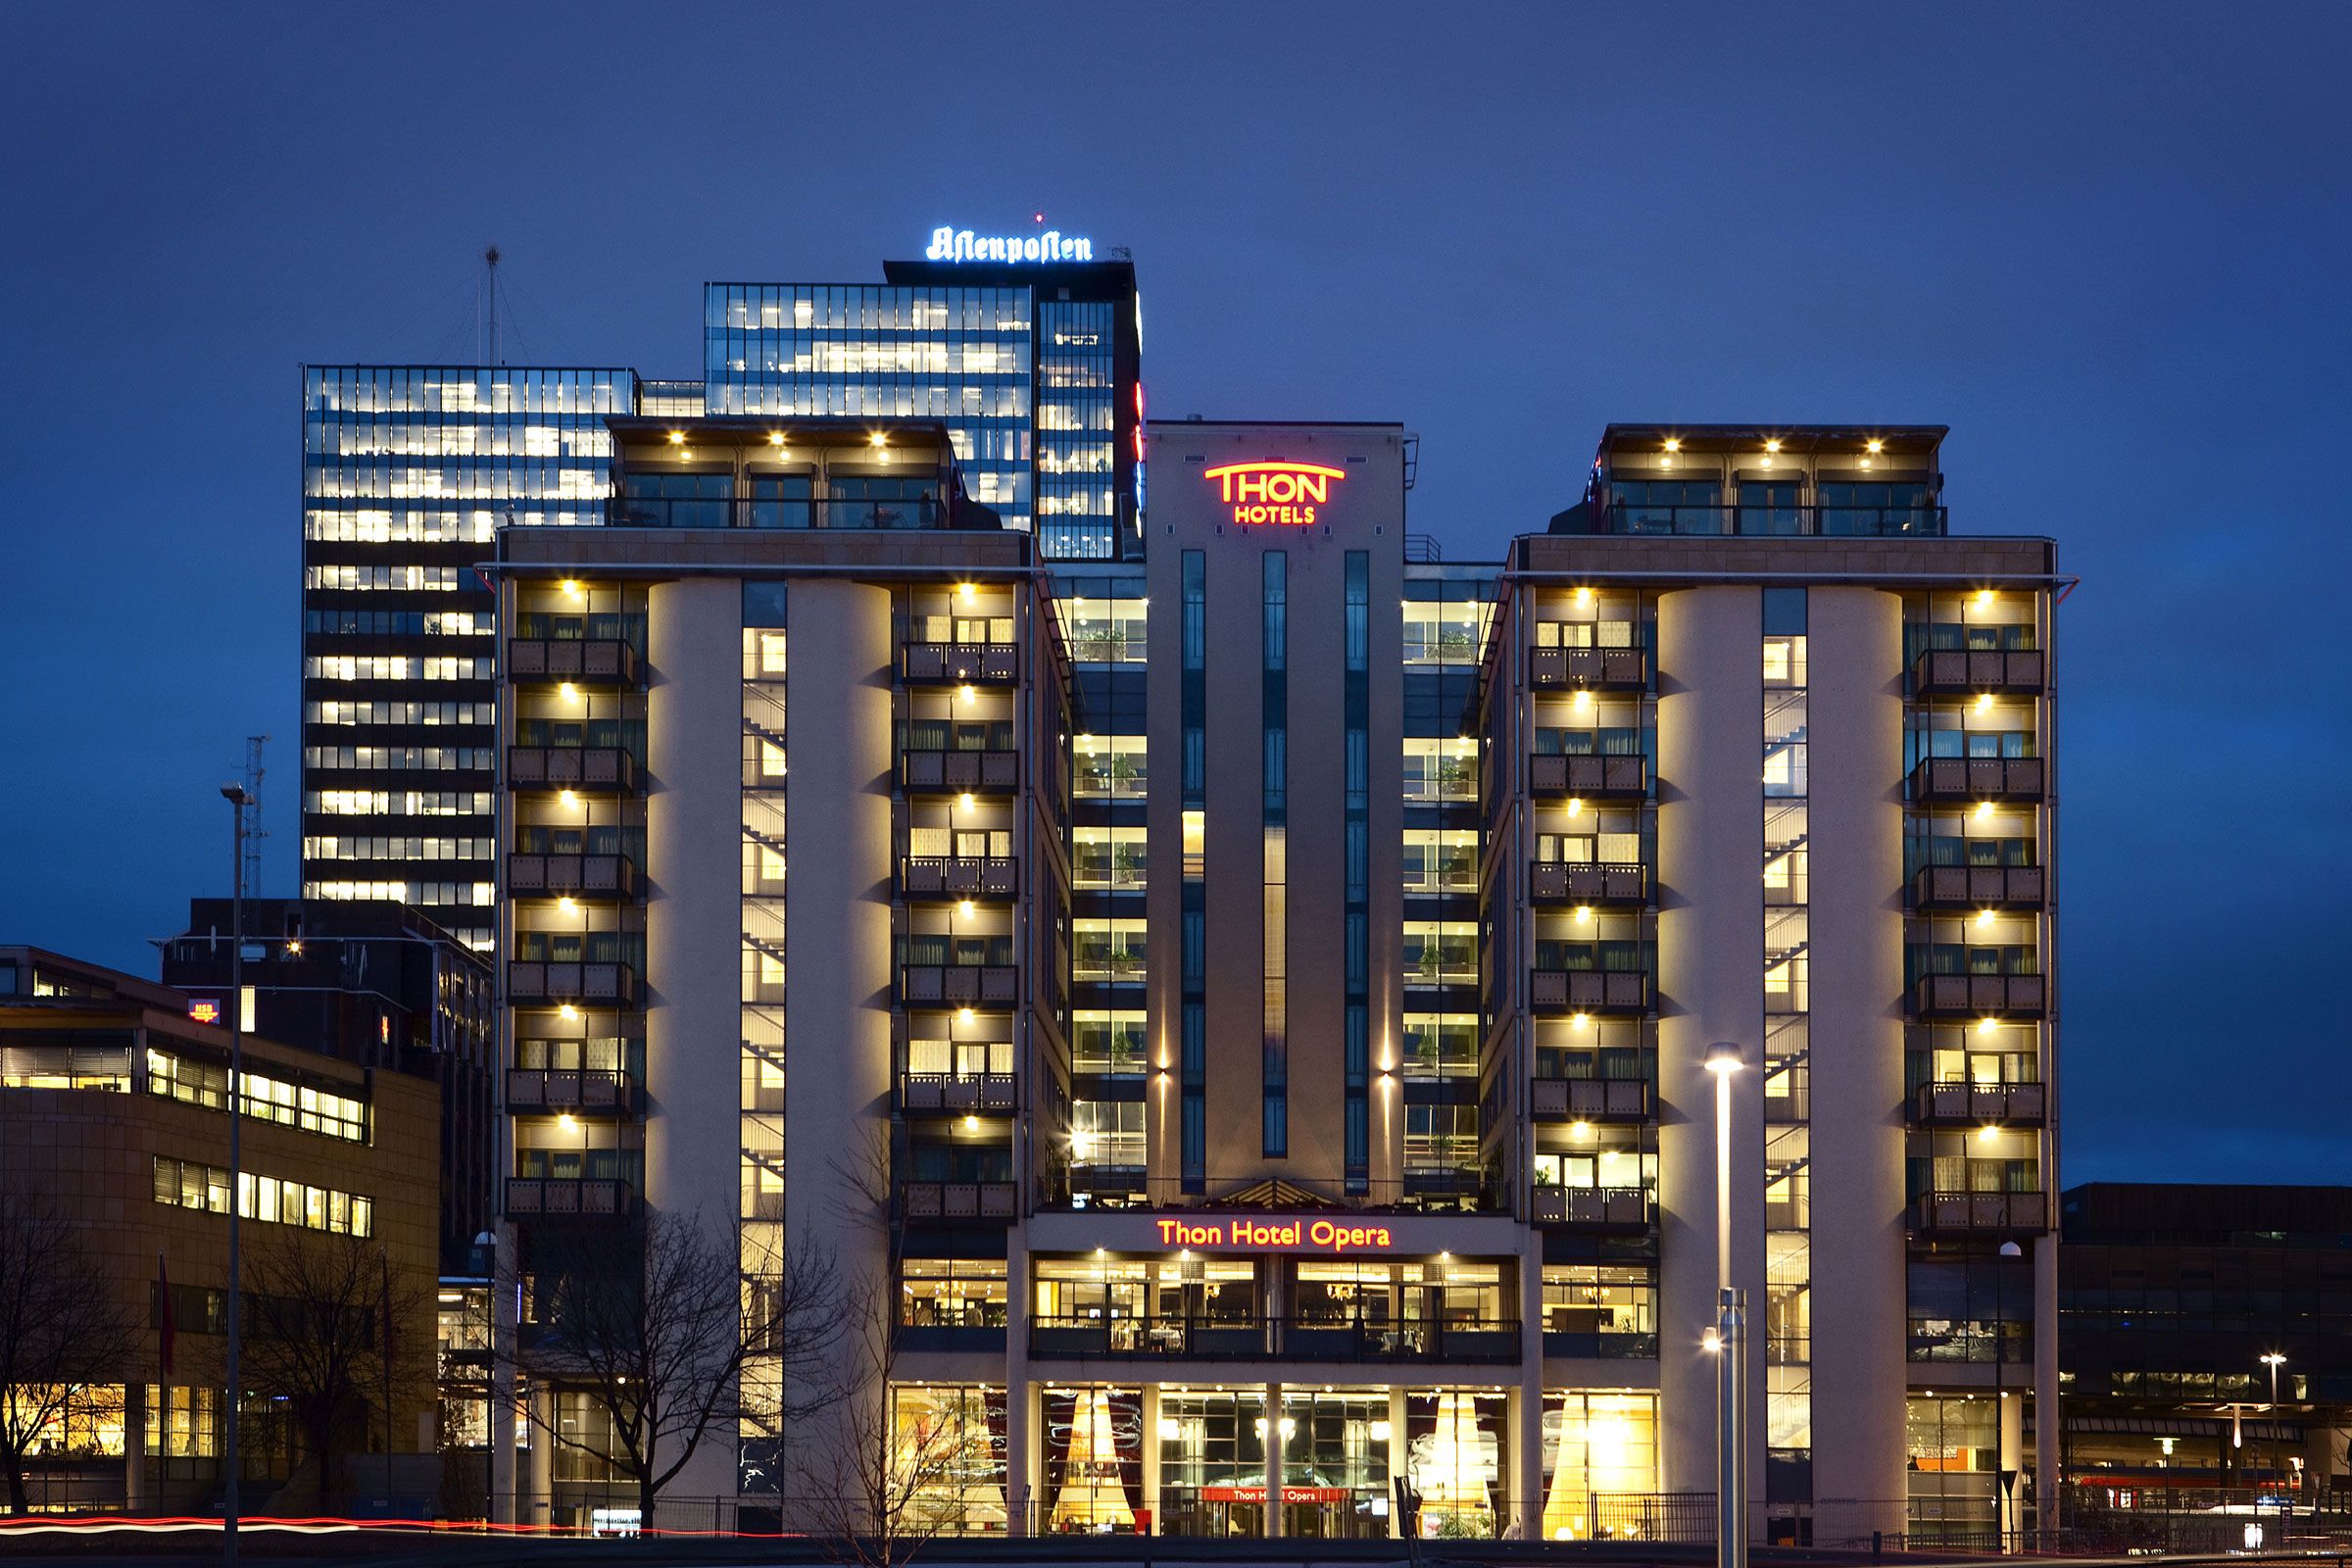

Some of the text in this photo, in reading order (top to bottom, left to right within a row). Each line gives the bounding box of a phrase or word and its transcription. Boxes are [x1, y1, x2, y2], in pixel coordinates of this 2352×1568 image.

[1204, 461, 1346, 504] THON
[1234, 505, 1315, 524] HOTELS
[1156, 1220, 1391, 1252] Thon Hotel Opera
[1233, 1490, 1256, 1500] Thon
[1287, 1491, 1316, 1502] Opera
